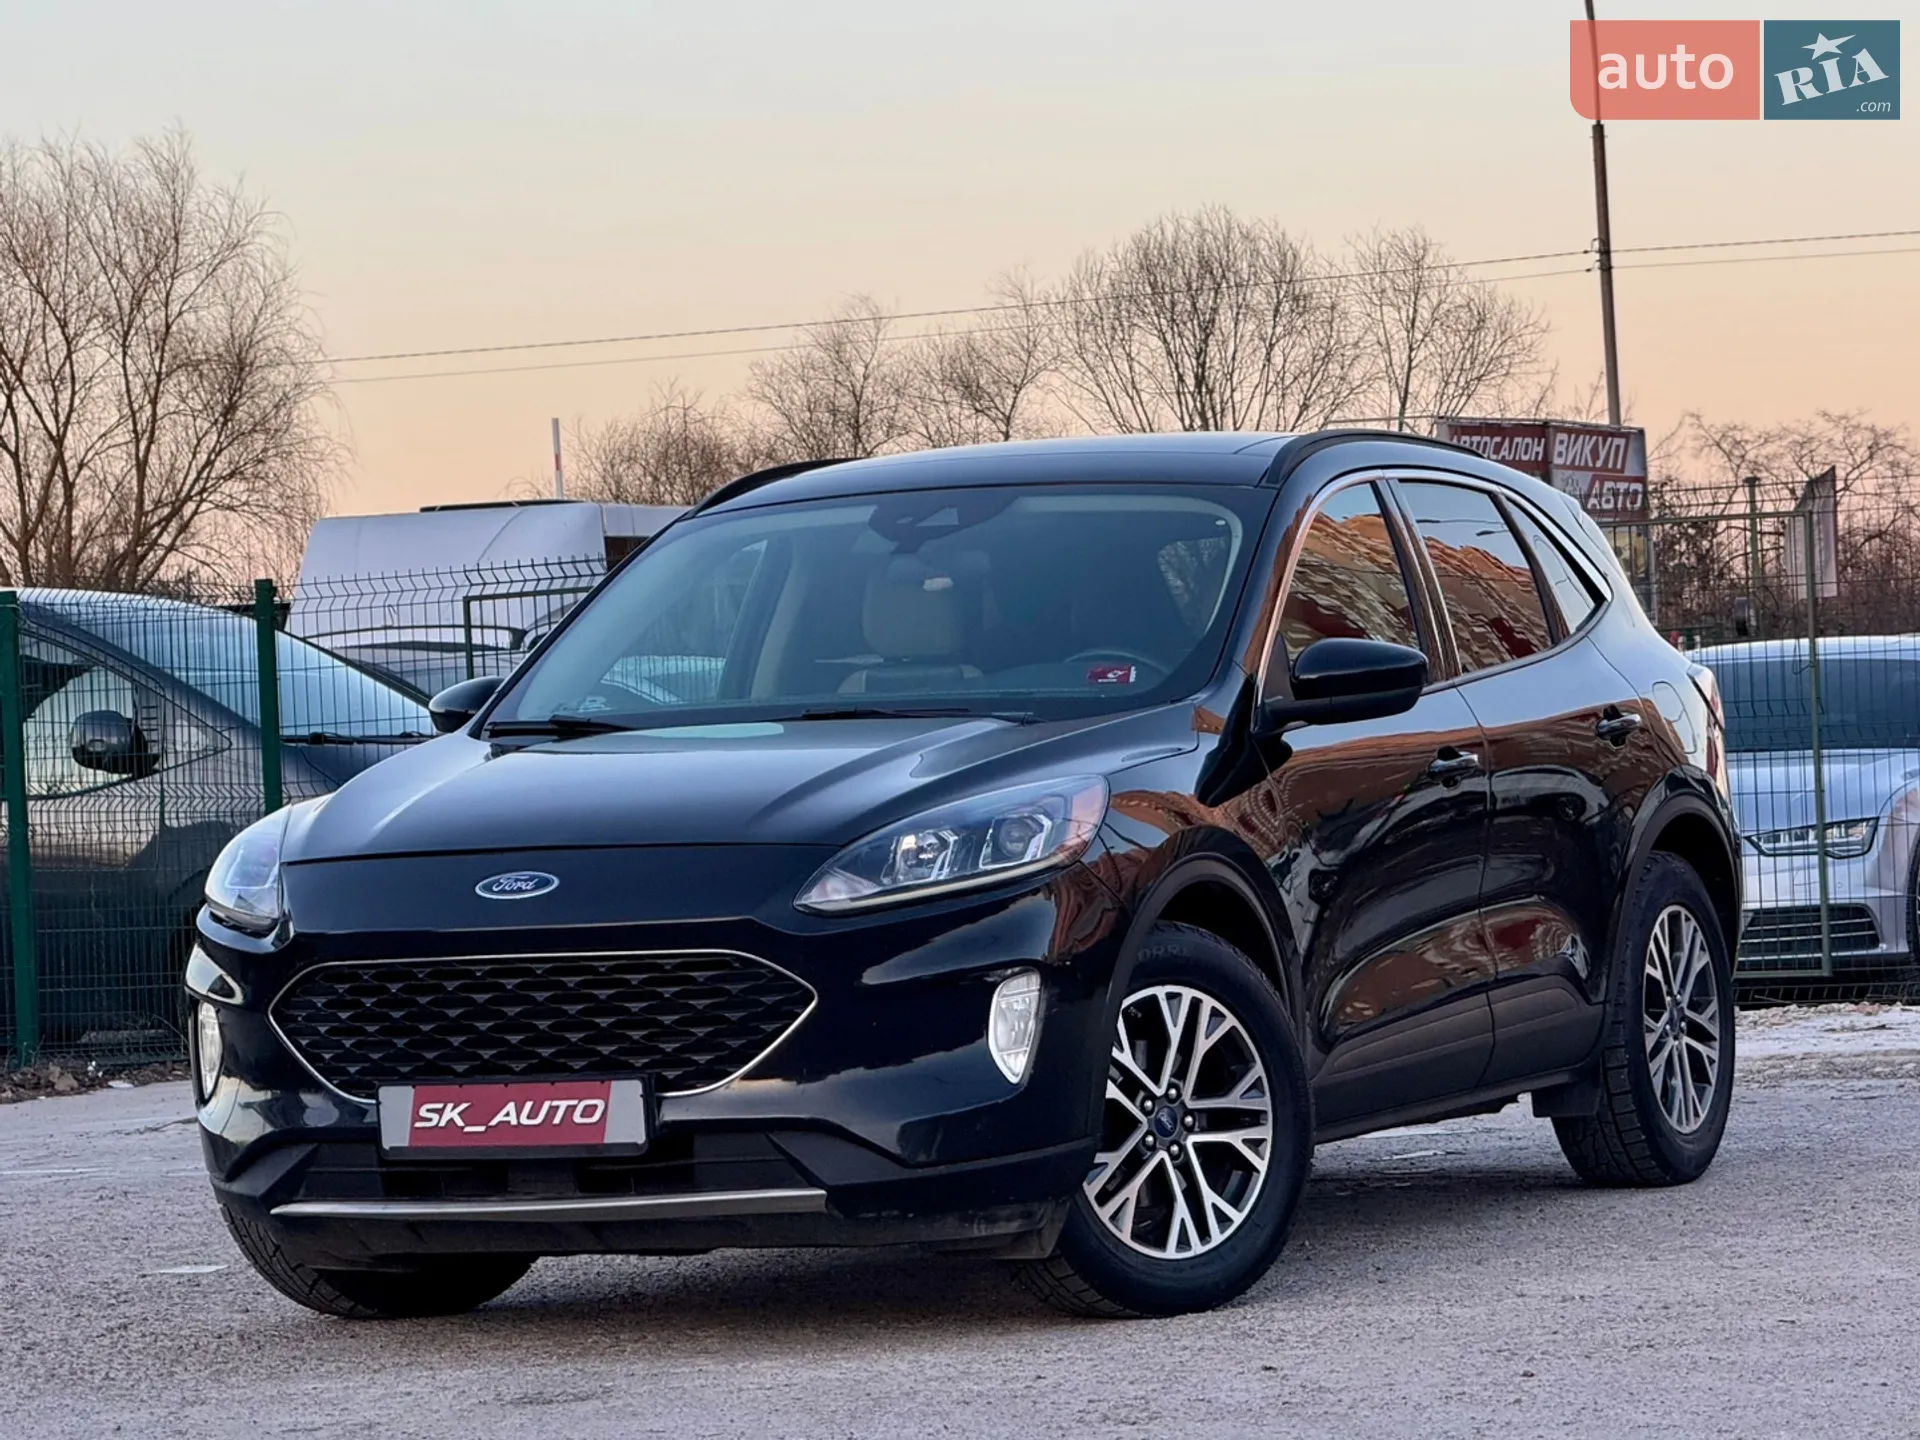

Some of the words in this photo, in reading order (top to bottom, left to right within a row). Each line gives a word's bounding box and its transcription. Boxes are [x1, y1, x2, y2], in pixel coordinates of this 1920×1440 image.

[1553, 432, 1627, 470] ВИКУП
[1586, 479, 1644, 512] АВТО
[491, 875, 539, 892] Ford
[413, 1098, 606, 1133] SK_AUTO
